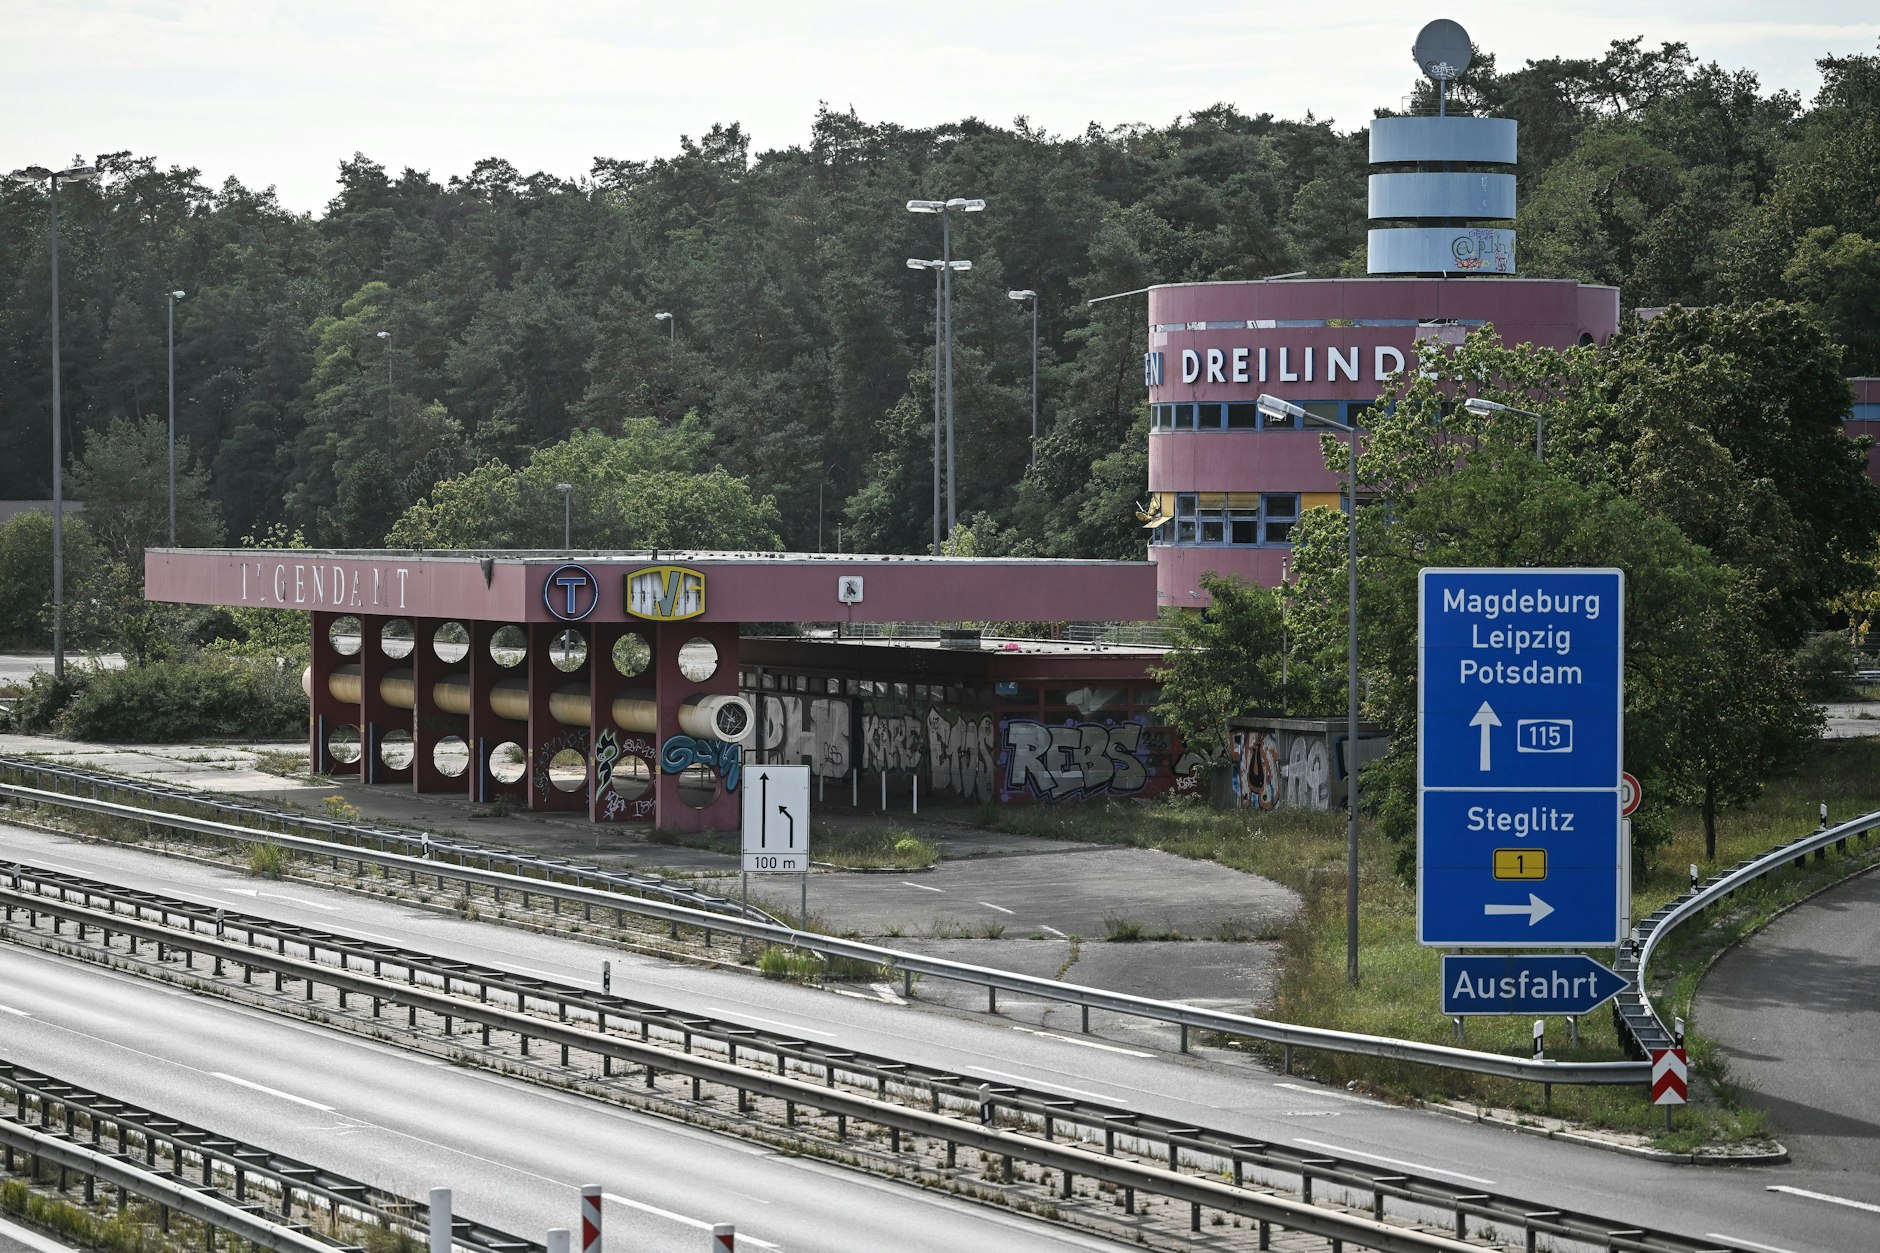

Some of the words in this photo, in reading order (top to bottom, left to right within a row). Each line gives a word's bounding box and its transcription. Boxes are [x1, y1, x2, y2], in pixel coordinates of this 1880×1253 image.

[1443, 588, 1600, 620] Magdeburg
[1472, 624, 1570, 655] Leipzig
[1460, 659, 1582, 685] Potsdam
[1529, 726, 1560, 746] 115
[1467, 806, 1574, 838] Steglitz
[754, 856, 777, 869] 100
[783, 860, 796, 869] m
[1516, 855, 1524, 874] 1
[1452, 970, 1598, 999] Ausfahrt
